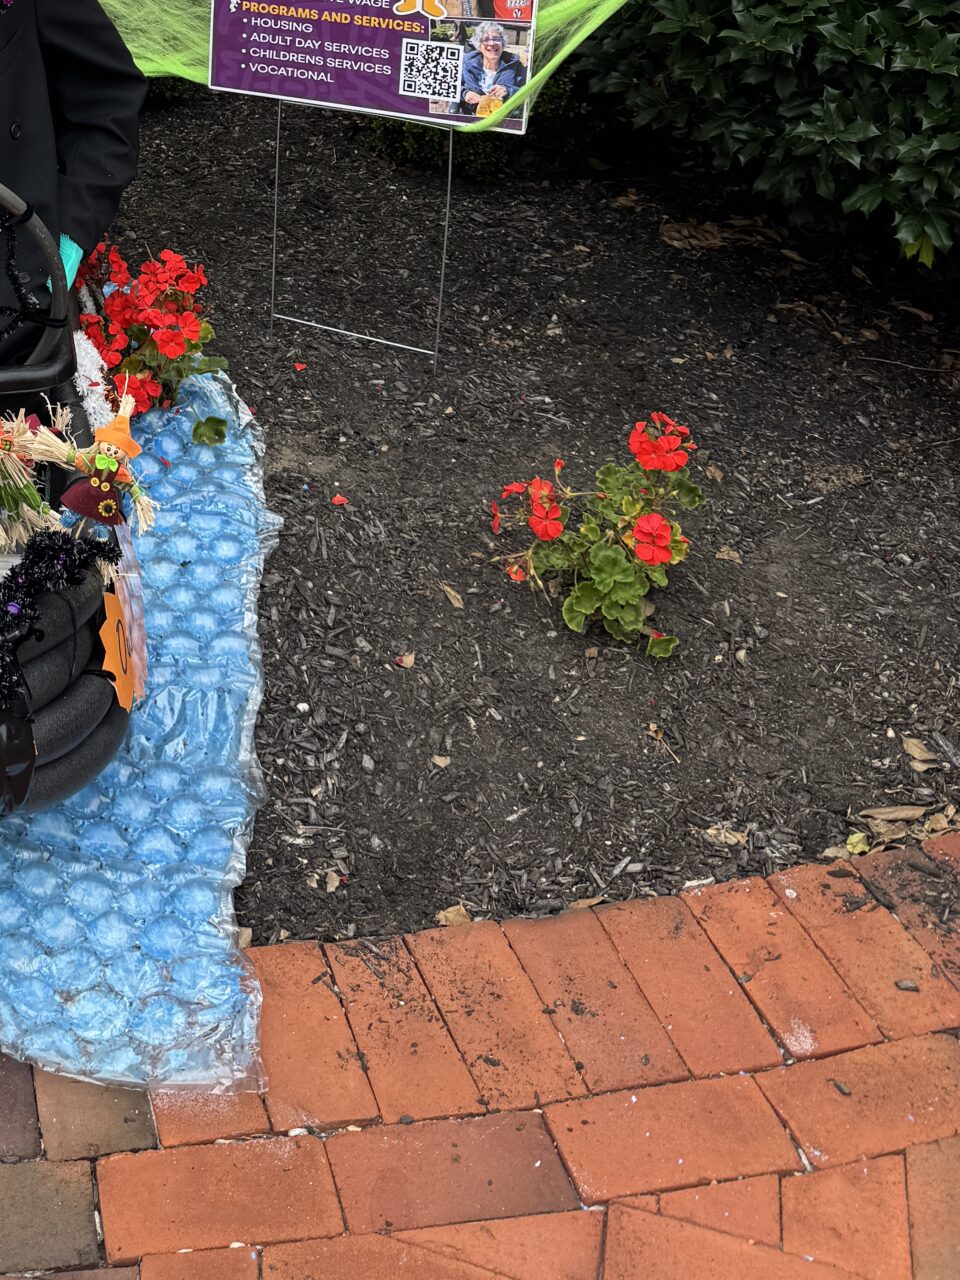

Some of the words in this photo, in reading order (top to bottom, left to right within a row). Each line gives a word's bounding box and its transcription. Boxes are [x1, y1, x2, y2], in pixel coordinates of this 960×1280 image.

[242, 1, 319, 20] PROGRAMS
[321, 10, 351, 24] AND
[353, 15, 425, 34] SERVICES:
[251, 17, 313, 33] HOUSING
[250, 32, 292, 46] ADULT
[295, 37, 322, 50] DAY
[324, 41, 390, 59] SERVICES
[249, 47, 324, 66] CHILDRENS
[326, 57, 392, 75] SERVICES
[249, 62, 335, 83] VOCATIONAL
